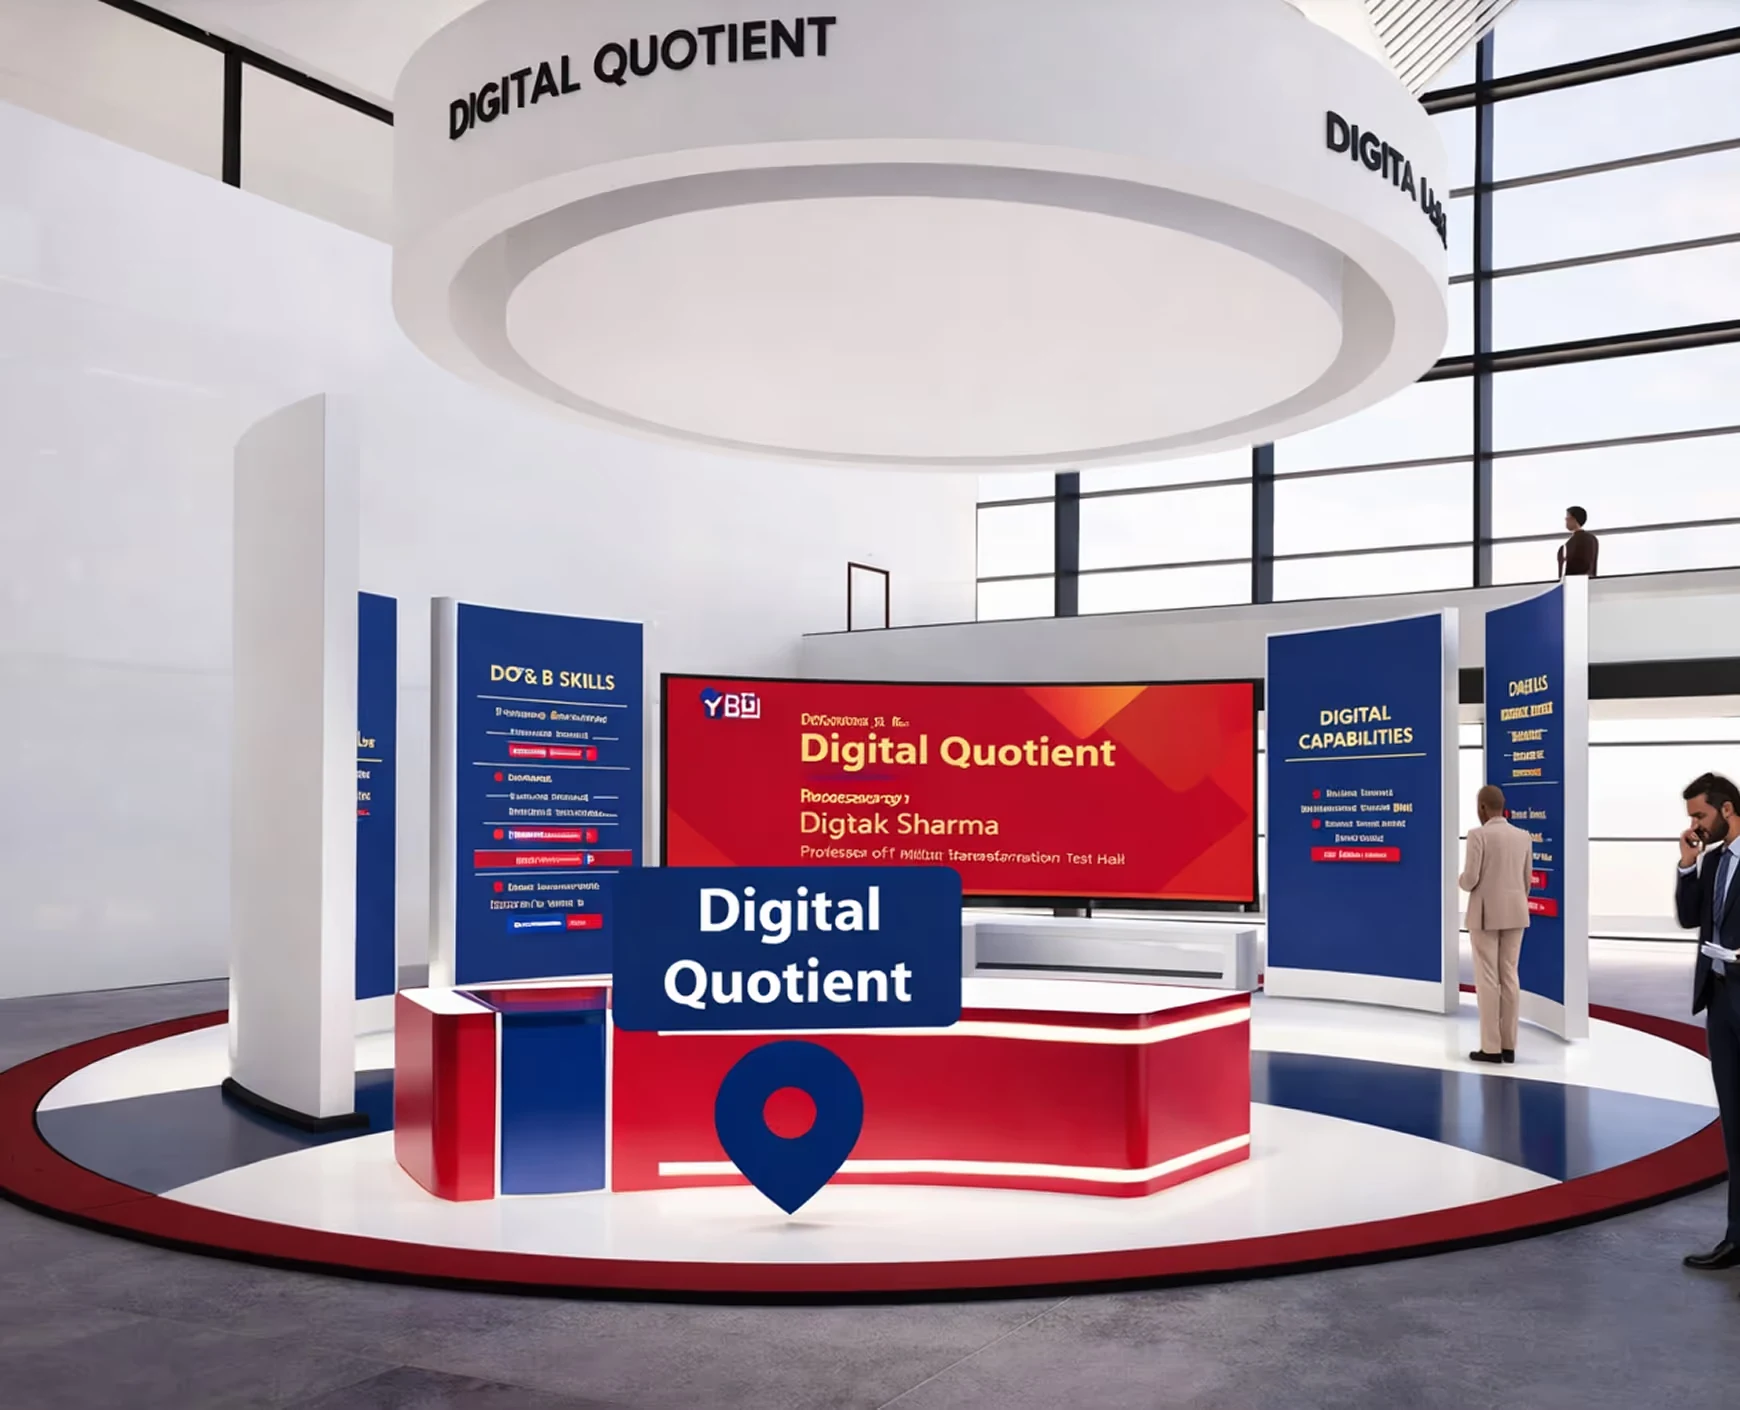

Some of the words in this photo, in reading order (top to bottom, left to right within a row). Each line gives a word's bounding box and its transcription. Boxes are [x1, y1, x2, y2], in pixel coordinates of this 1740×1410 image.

[449, 55, 581, 140] DIGITAL
[593, 16, 837, 86] QUOTIENT
[559, 671, 616, 691] SKILLS
[1320, 705, 1392, 726] DIGITAL
[1299, 727, 1414, 750] CAPABILITIES
[801, 732, 928, 772] Digital
[940, 735, 1117, 769] Quotient
[897, 813, 1000, 835] Sharma
[1066, 852, 1093, 865] Test
[700, 886, 880, 944] Digital
[664, 956, 913, 1010] Quotient
